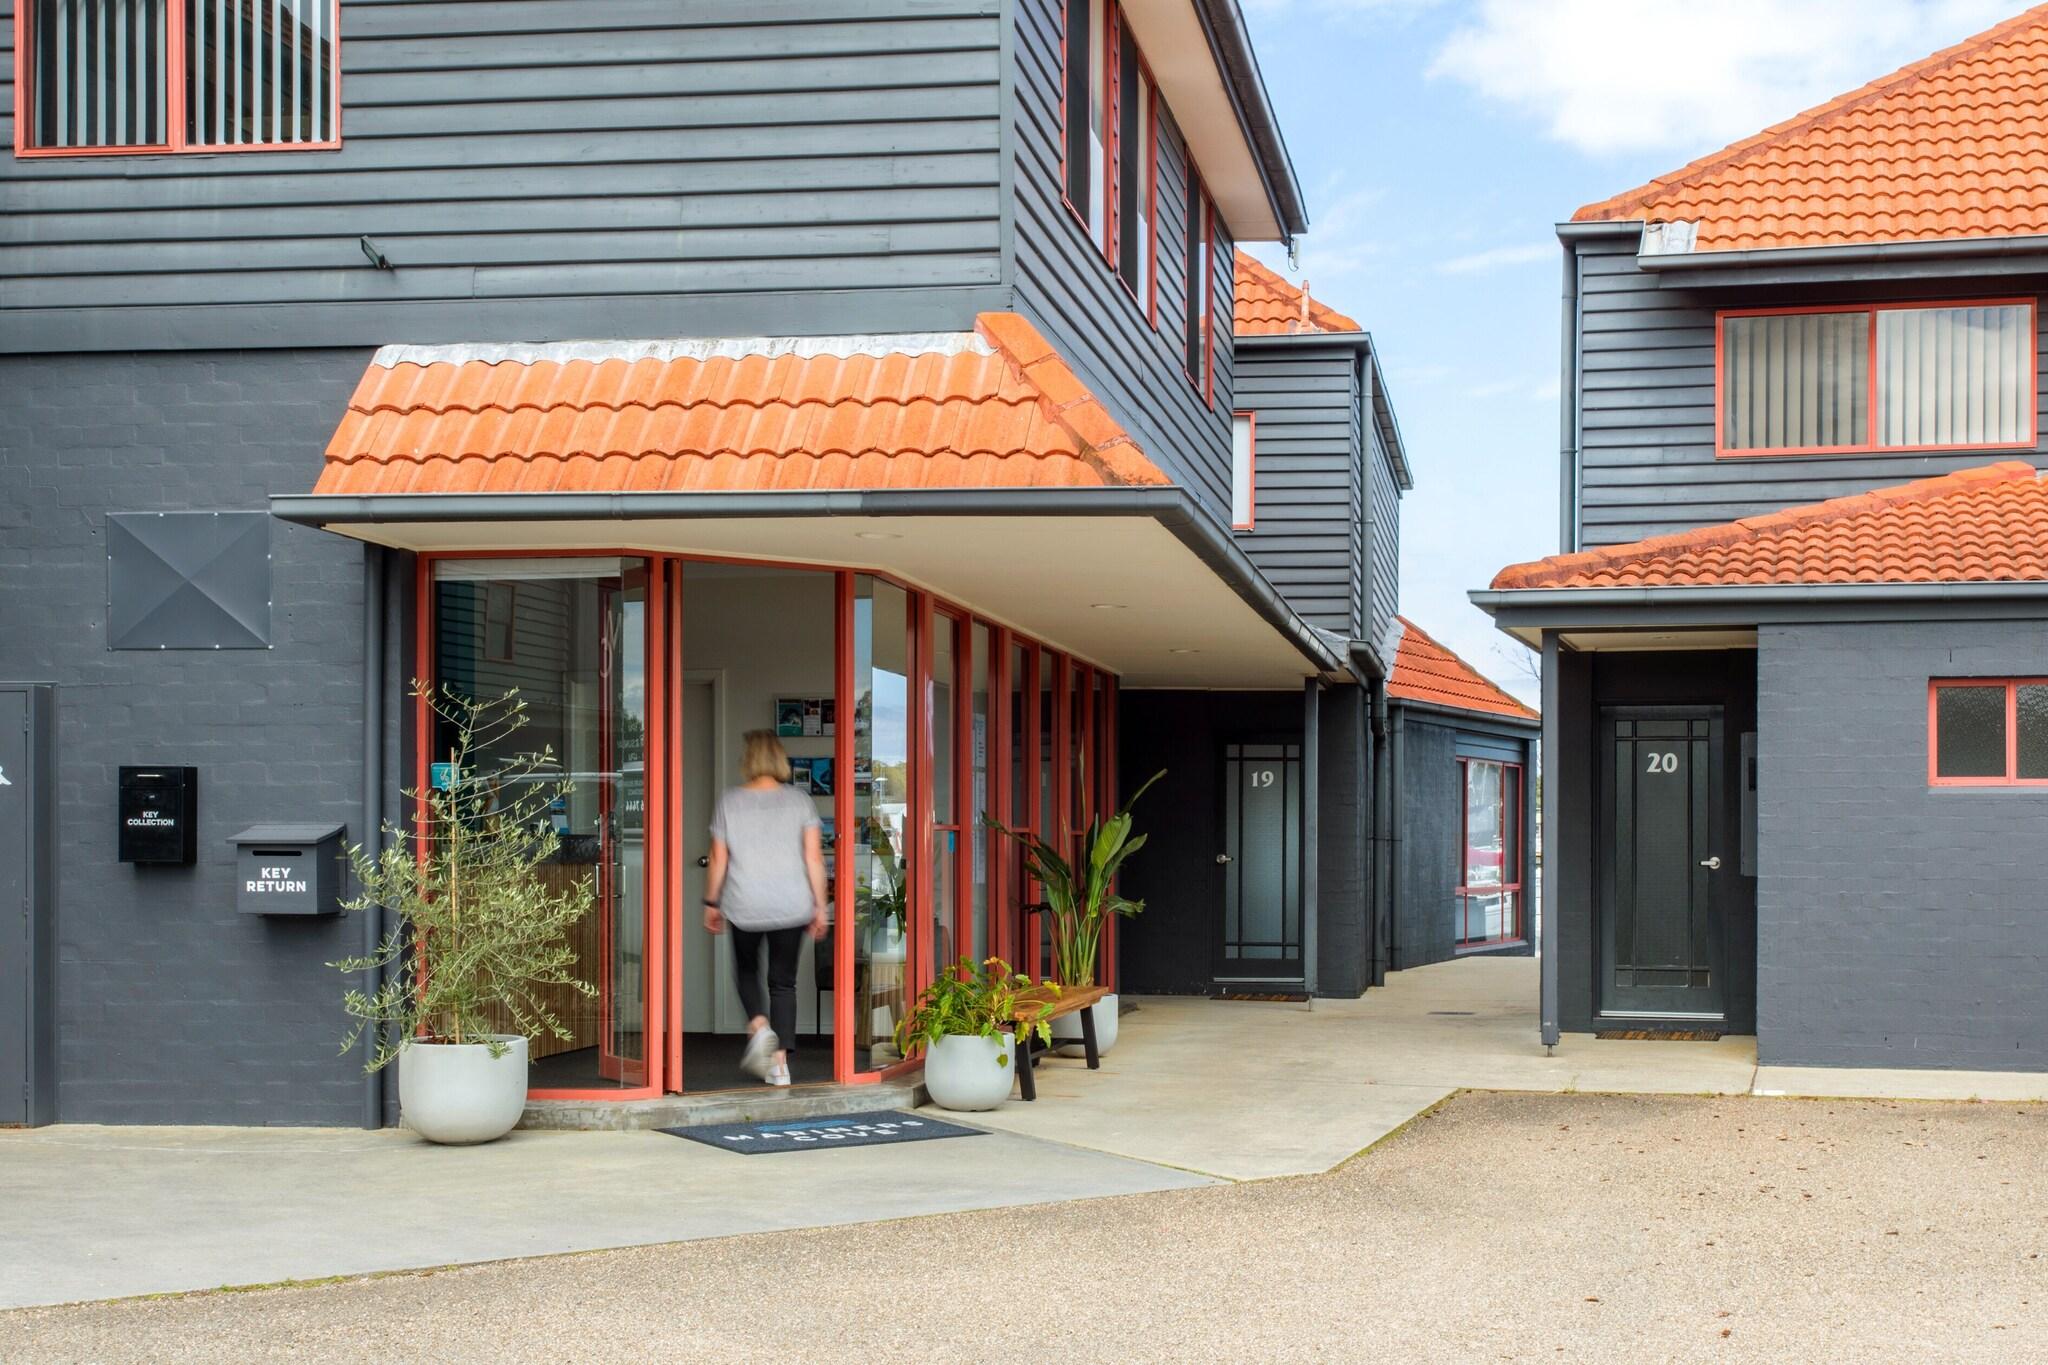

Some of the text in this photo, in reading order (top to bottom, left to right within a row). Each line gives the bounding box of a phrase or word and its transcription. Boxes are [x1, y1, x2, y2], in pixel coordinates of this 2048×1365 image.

[1646, 752, 1678, 773] 20
[1252, 770, 1274, 787] 19
[127, 818, 174, 826] COLLECTION
[261, 867, 291, 879] KEY
[246, 880, 307, 892] RETURN
[723, 1120, 924, 1141] MARINERS
[793, 1129, 898, 1141] COVE
